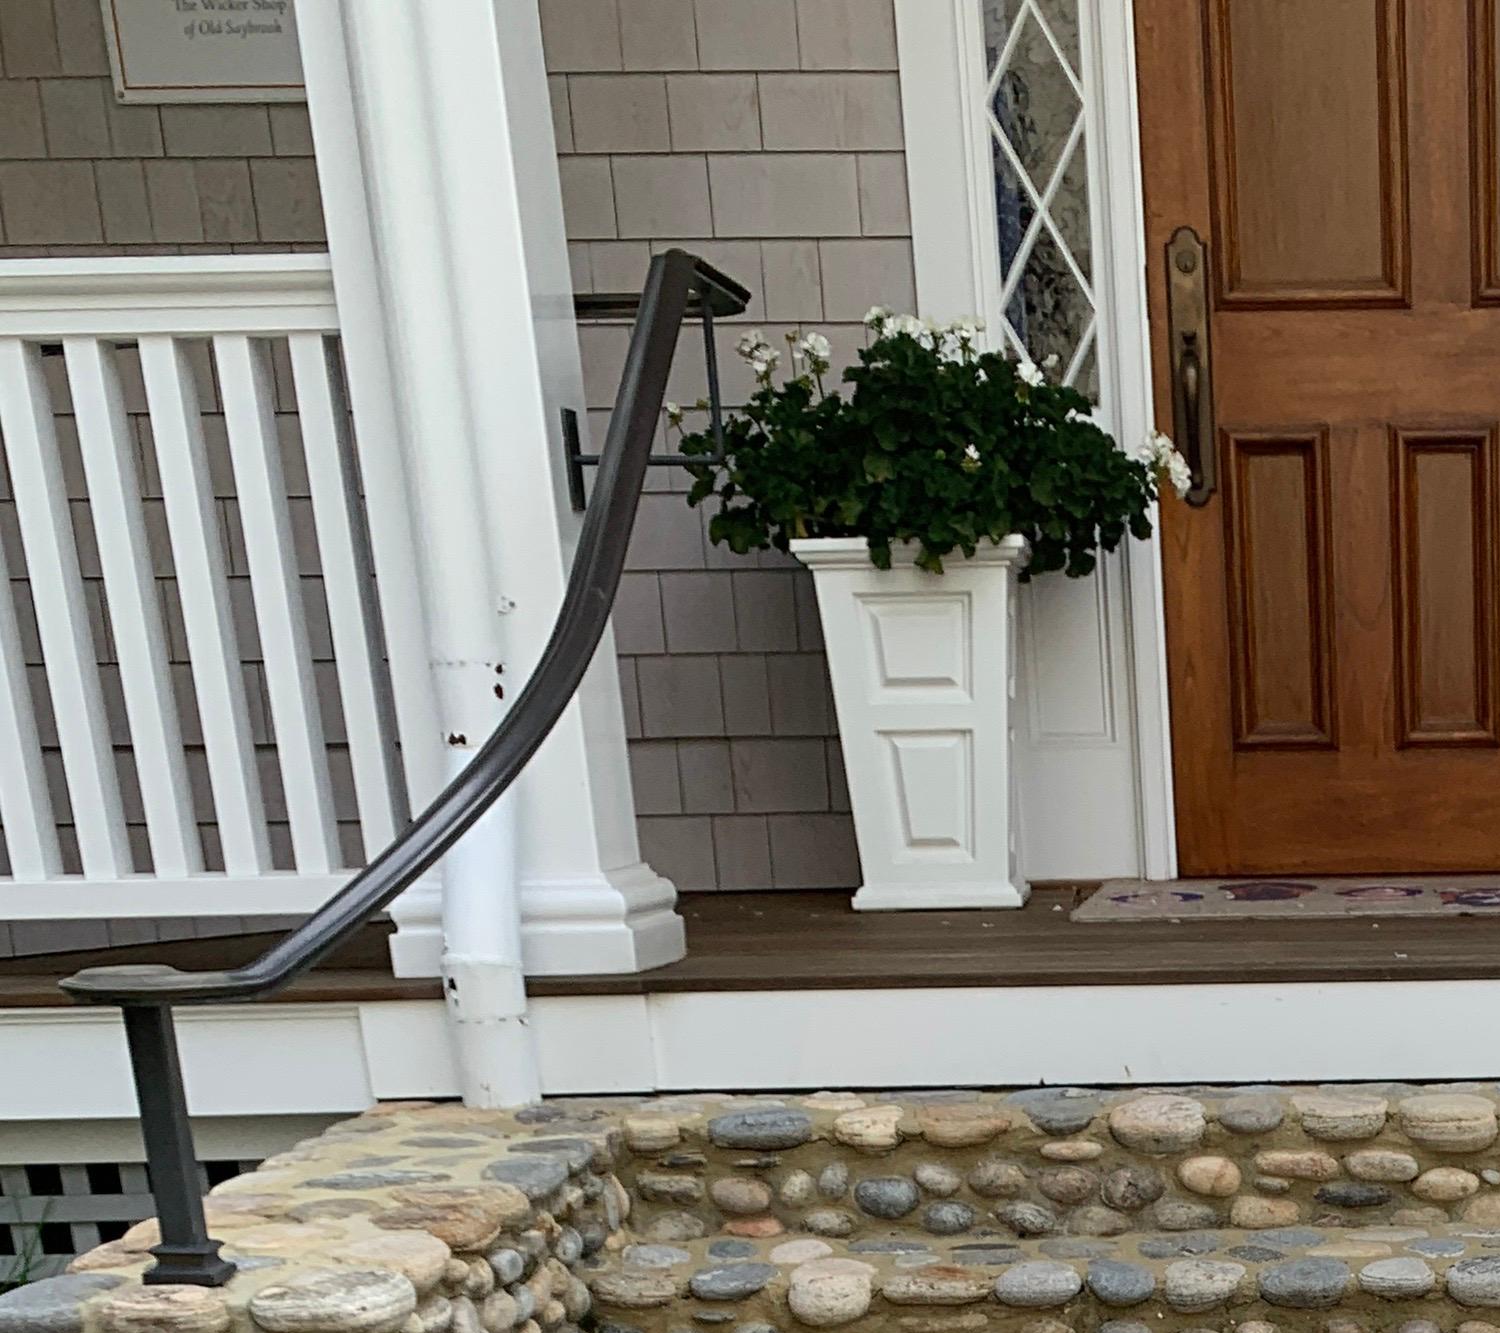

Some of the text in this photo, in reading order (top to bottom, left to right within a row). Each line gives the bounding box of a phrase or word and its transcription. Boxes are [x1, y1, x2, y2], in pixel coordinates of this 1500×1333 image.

[171, 0, 287, 15] The Wicker Shop
[183, 19, 195, 40] of
[198, 19, 222, 35] Old
